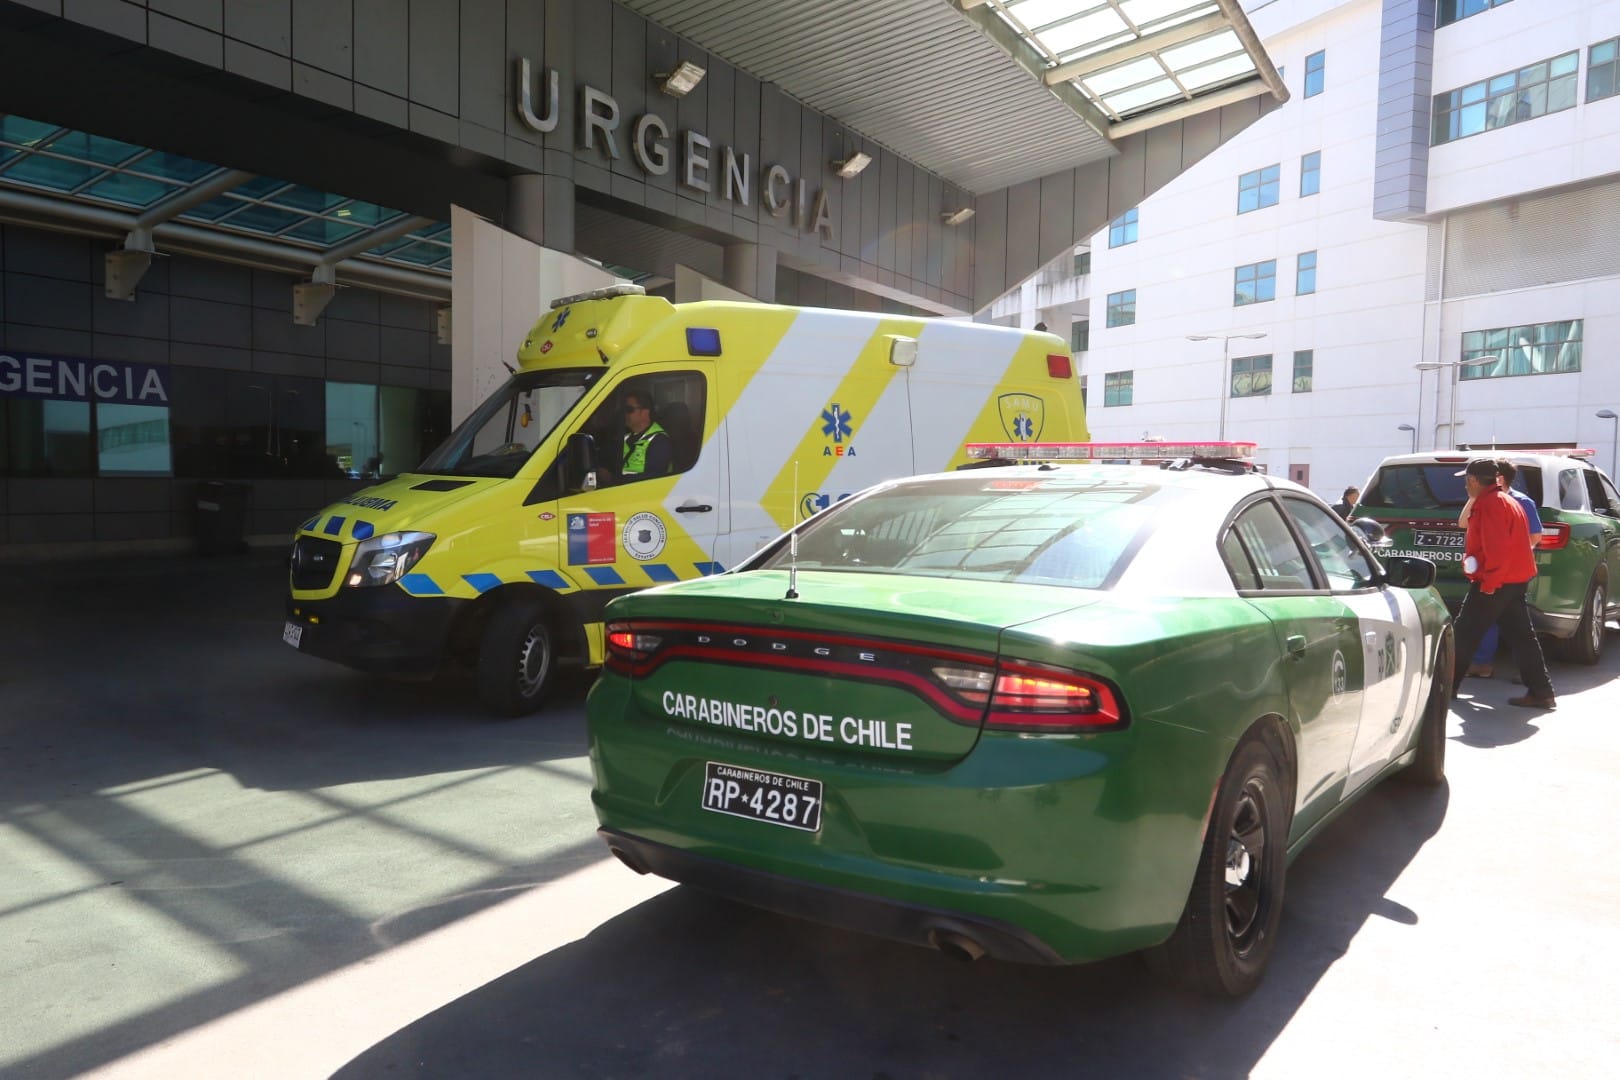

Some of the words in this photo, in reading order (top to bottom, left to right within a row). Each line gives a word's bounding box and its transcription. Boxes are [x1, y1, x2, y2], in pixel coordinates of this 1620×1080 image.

[518, 57, 834, 240] URGENCIA
[0, 355, 168, 401] GENCIA
[823, 446, 856, 456] AEA
[698, 636, 875, 661] DODGE
[663, 691, 797, 737] CARABINEROS
[803, 713, 834, 742] DE
[840, 717, 912, 750] CHILE
[717, 767, 770, 784] CARABINEROS
[772, 778, 783, 787] DE
[786, 778, 809, 791] CHILE
